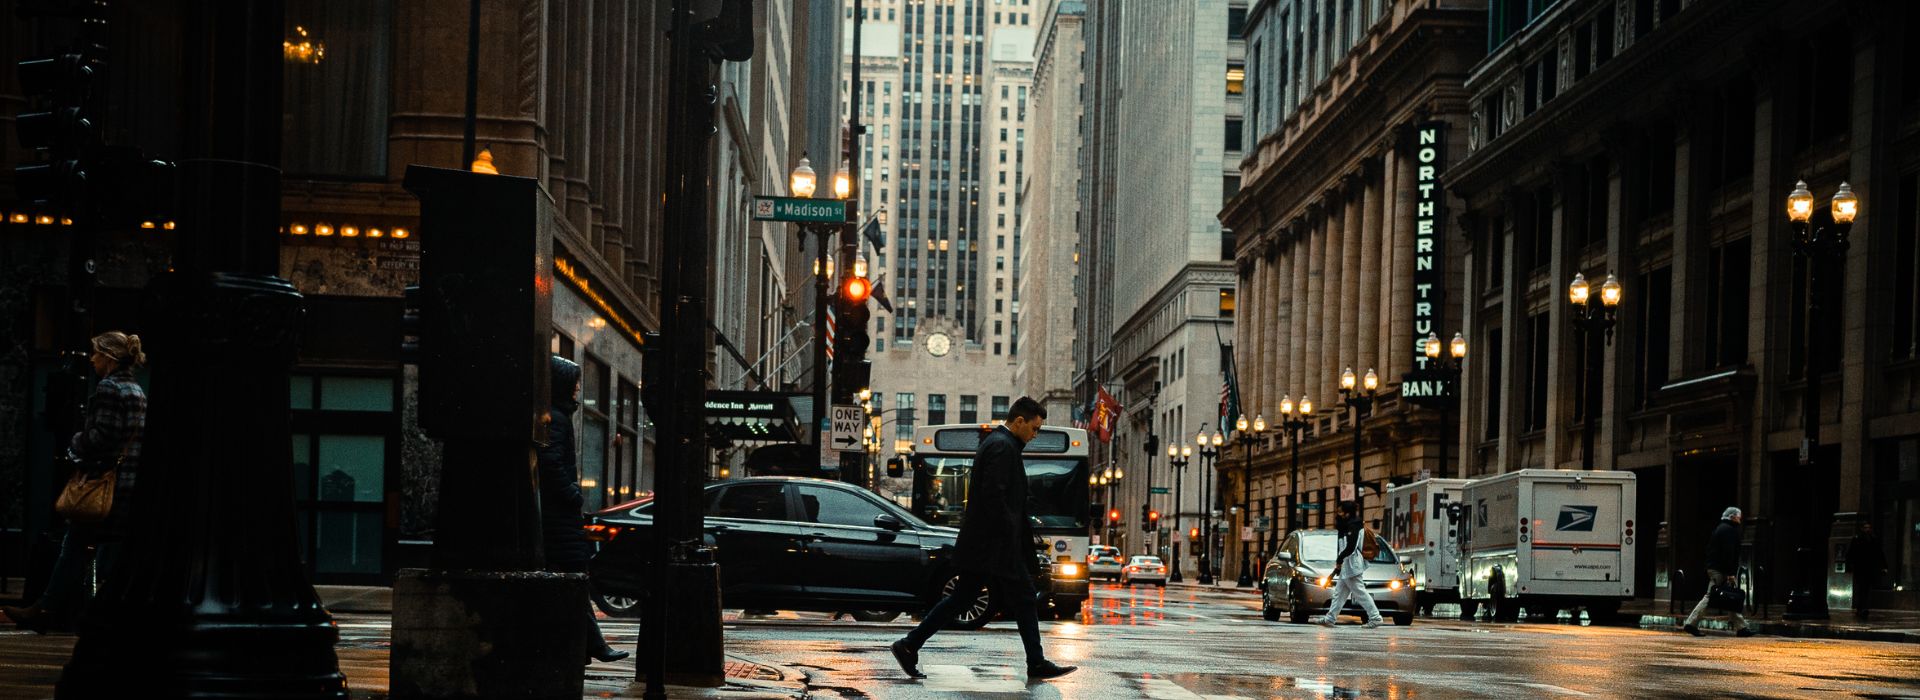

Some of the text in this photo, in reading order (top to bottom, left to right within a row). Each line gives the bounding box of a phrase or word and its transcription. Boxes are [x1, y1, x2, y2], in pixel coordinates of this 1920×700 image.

[785, 203, 832, 217] Madison
[1415, 129, 1436, 370] NORTHERN TRUST
[730, 402, 745, 410] Inn
[835, 409, 860, 421] ONE
[834, 421, 860, 433] WAY
